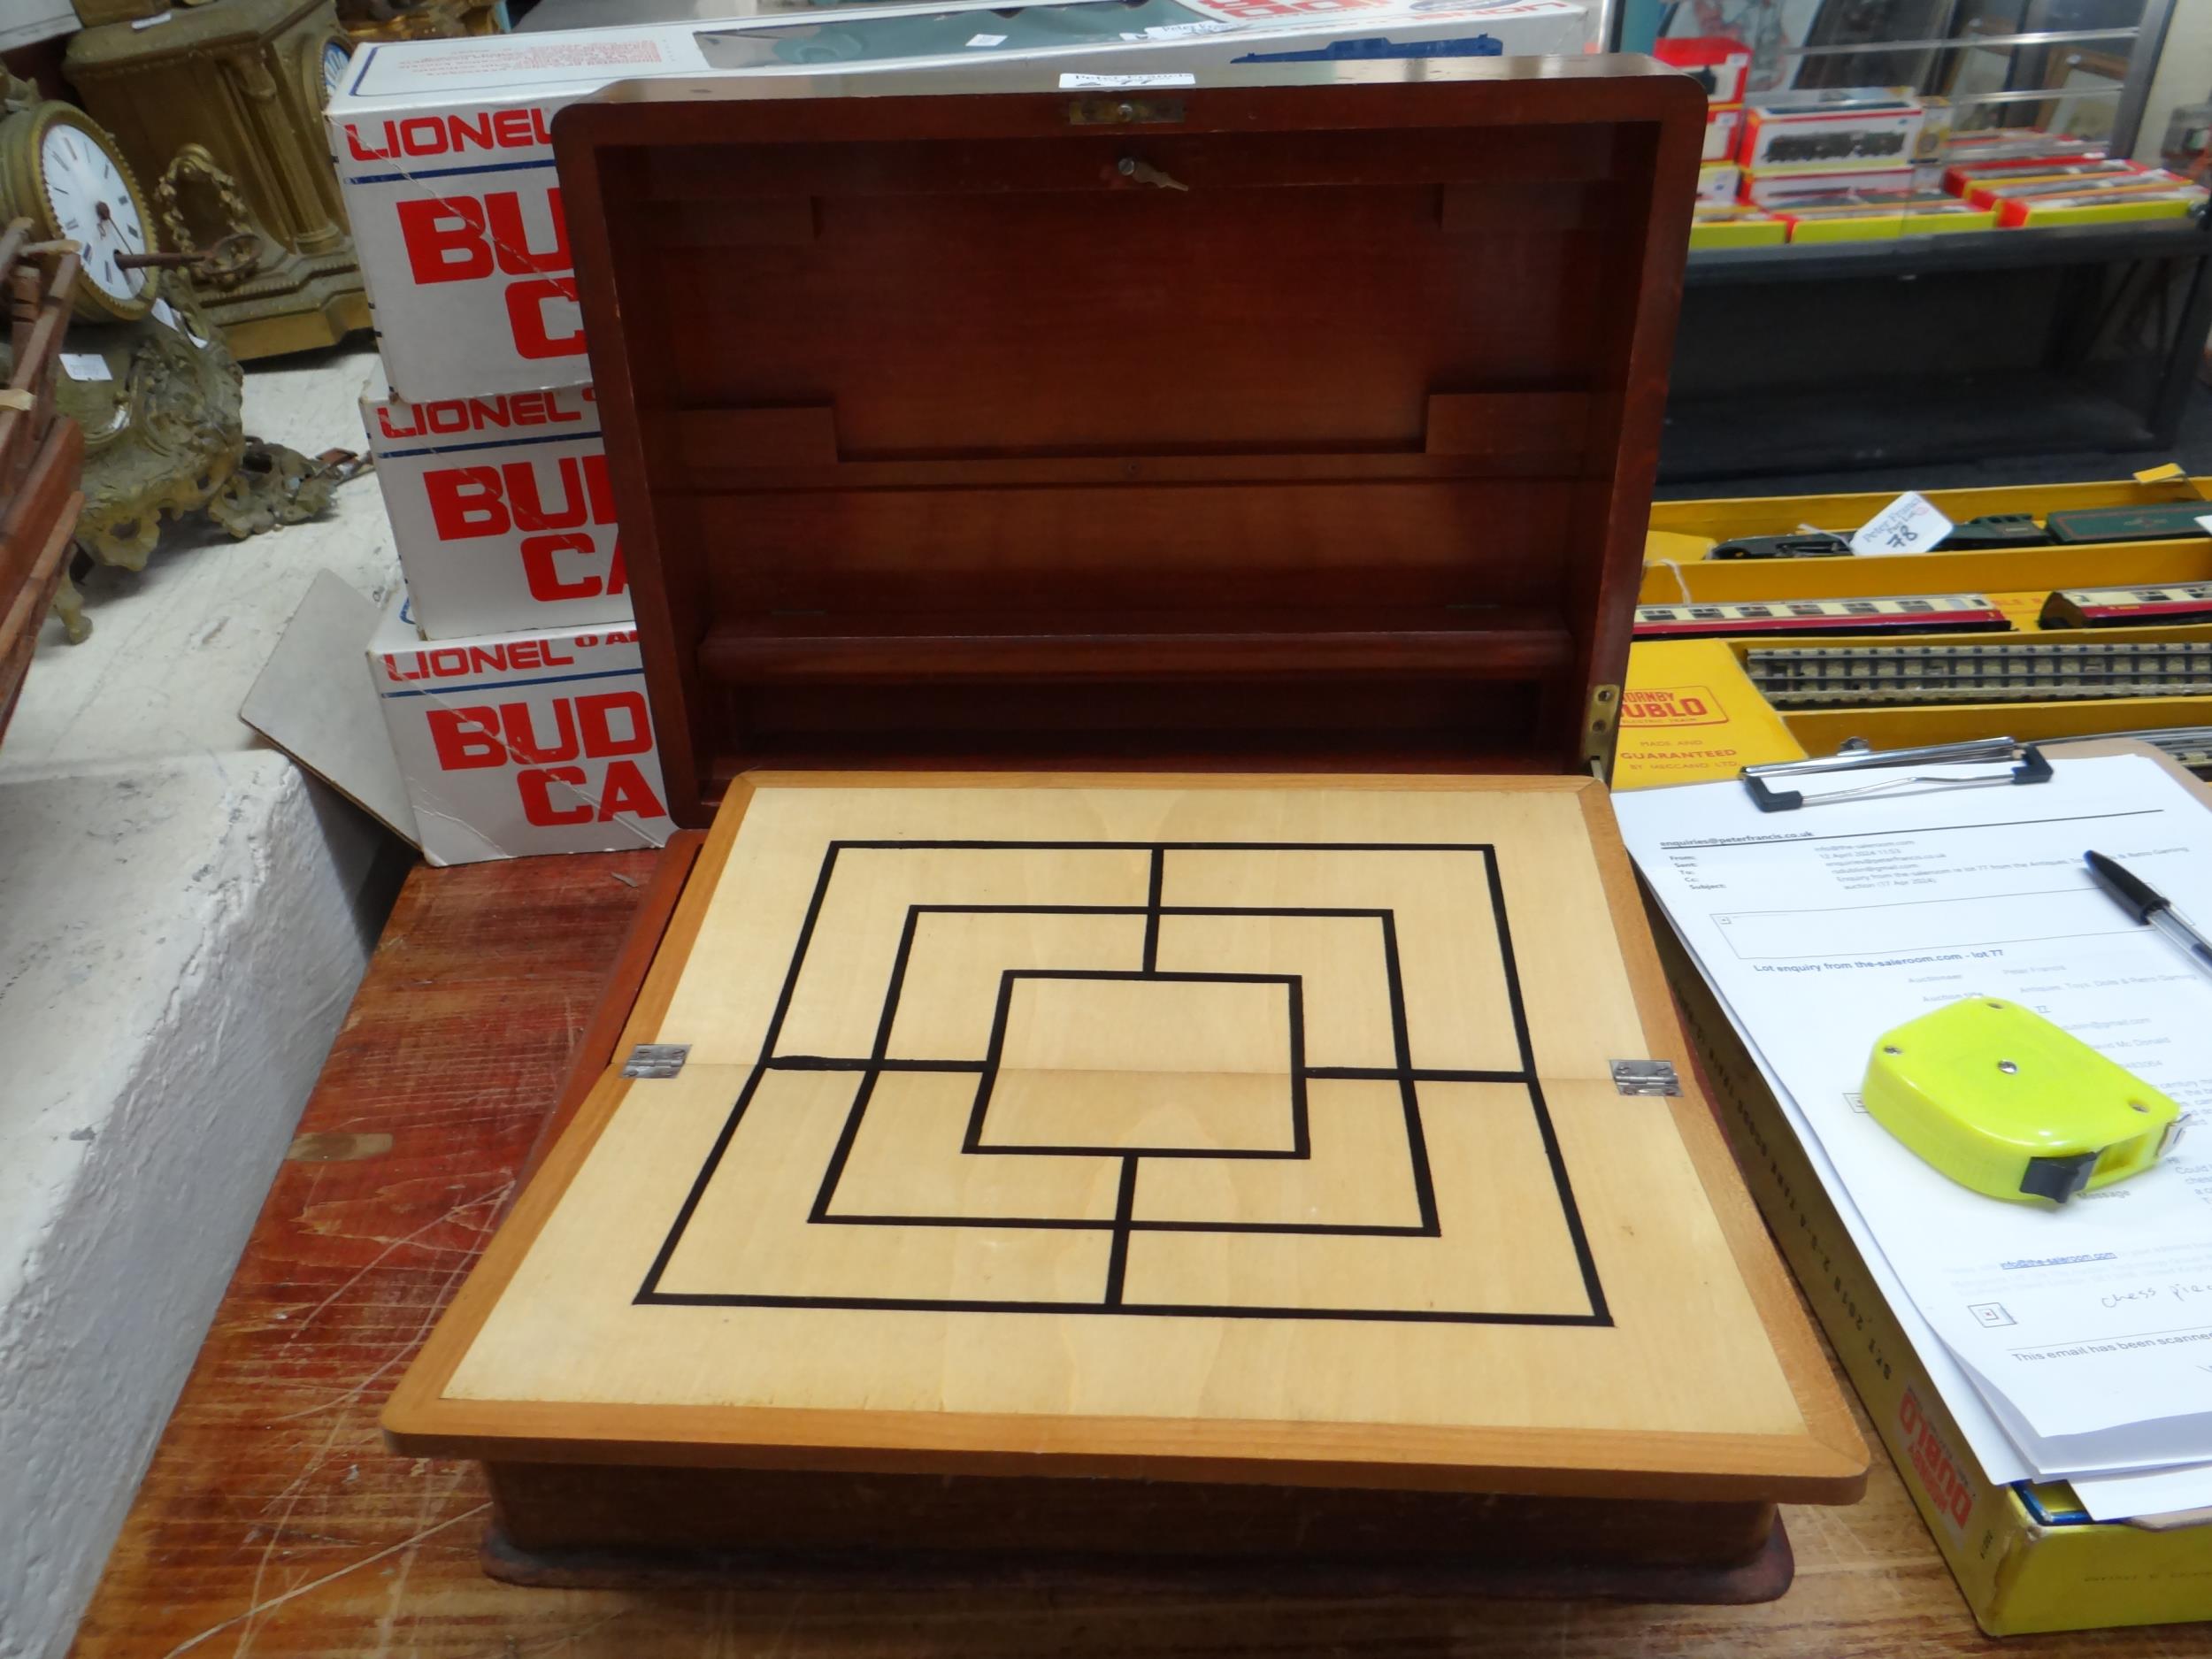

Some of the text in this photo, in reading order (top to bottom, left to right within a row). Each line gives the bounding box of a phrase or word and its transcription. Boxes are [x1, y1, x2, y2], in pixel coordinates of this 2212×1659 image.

[345, 107, 552, 161] LIONEL
[377, 392, 582, 439] LIONEL
[1886, 524, 1918, 548] 78
[383, 639, 574, 682] LIONEL
[1621, 697, 1708, 718] UBLO
[1620, 749, 1737, 760] GUARANTEED
[1660, 830, 1815, 848] enquiries@peterfrancis.co.uk
[1753, 964, 1775, 972] Lot
[1776, 964, 1821, 973] enquiry
[1824, 962, 1854, 971] from
[1855, 952, 1962, 969] the-saleroom.com
[1971, 950, 1988, 959] lot
[1989, 949, 2004, 957] 77
[2011, 1351, 2046, 1362] This
[2047, 1345, 2087, 1360] email
[2087, 1343, 2116, 1354] has
[2116, 1337, 2156, 1349] been
[1900, 1390, 1973, 1530] DUBLO
